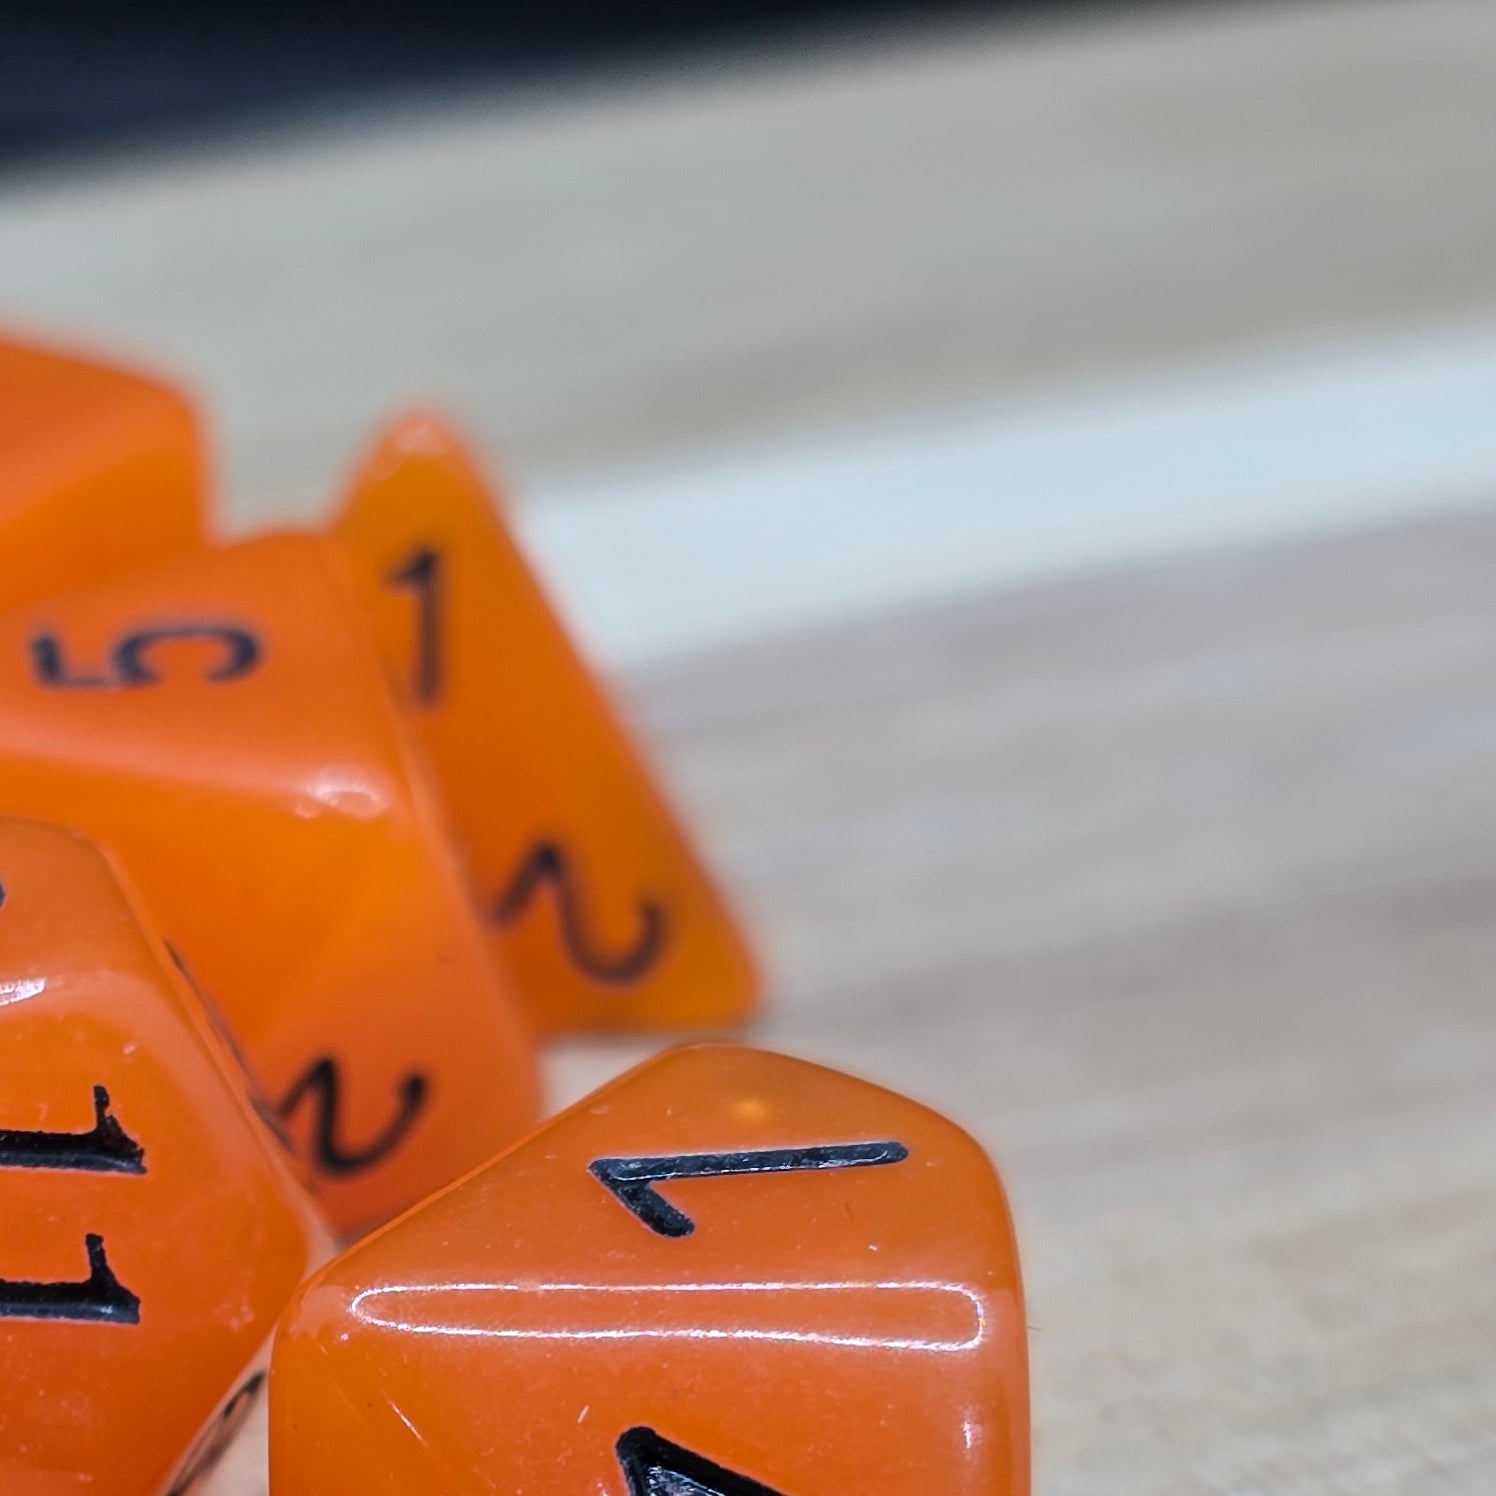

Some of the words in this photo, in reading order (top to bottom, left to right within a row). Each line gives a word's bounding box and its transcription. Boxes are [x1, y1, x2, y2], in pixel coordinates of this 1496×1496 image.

[28, 620, 264, 692] 5
[378, 546, 446, 714] 1
[482, 840, 674, 986] 2
[277, 1055, 428, 1180] 2
